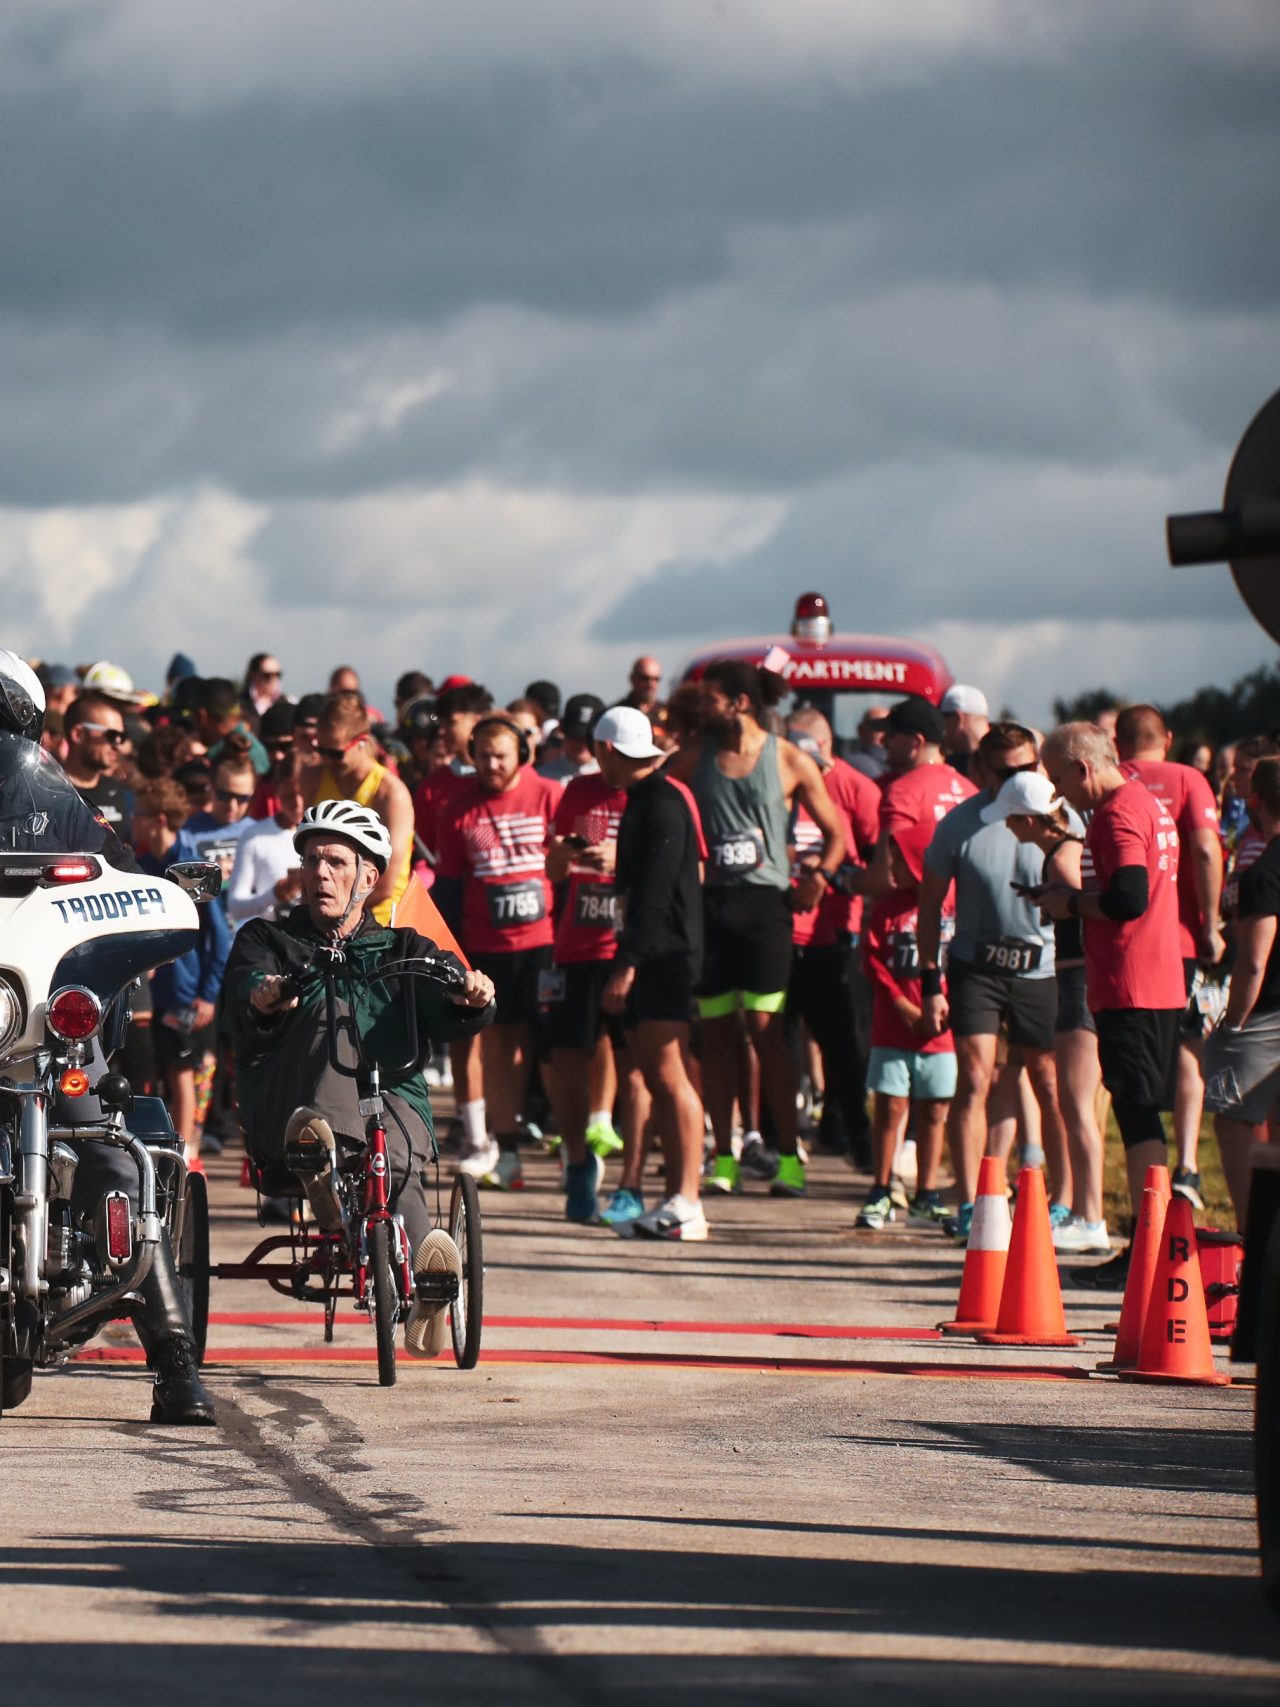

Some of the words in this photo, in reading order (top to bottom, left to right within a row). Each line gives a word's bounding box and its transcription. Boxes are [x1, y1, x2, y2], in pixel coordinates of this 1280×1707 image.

[782, 658, 908, 683] PARTMENT
[714, 841, 757, 866] 7939
[51, 888, 166, 924] TROOPER
[985, 944, 1033, 971] 7981
[1167, 1236, 1190, 1344] RDE
